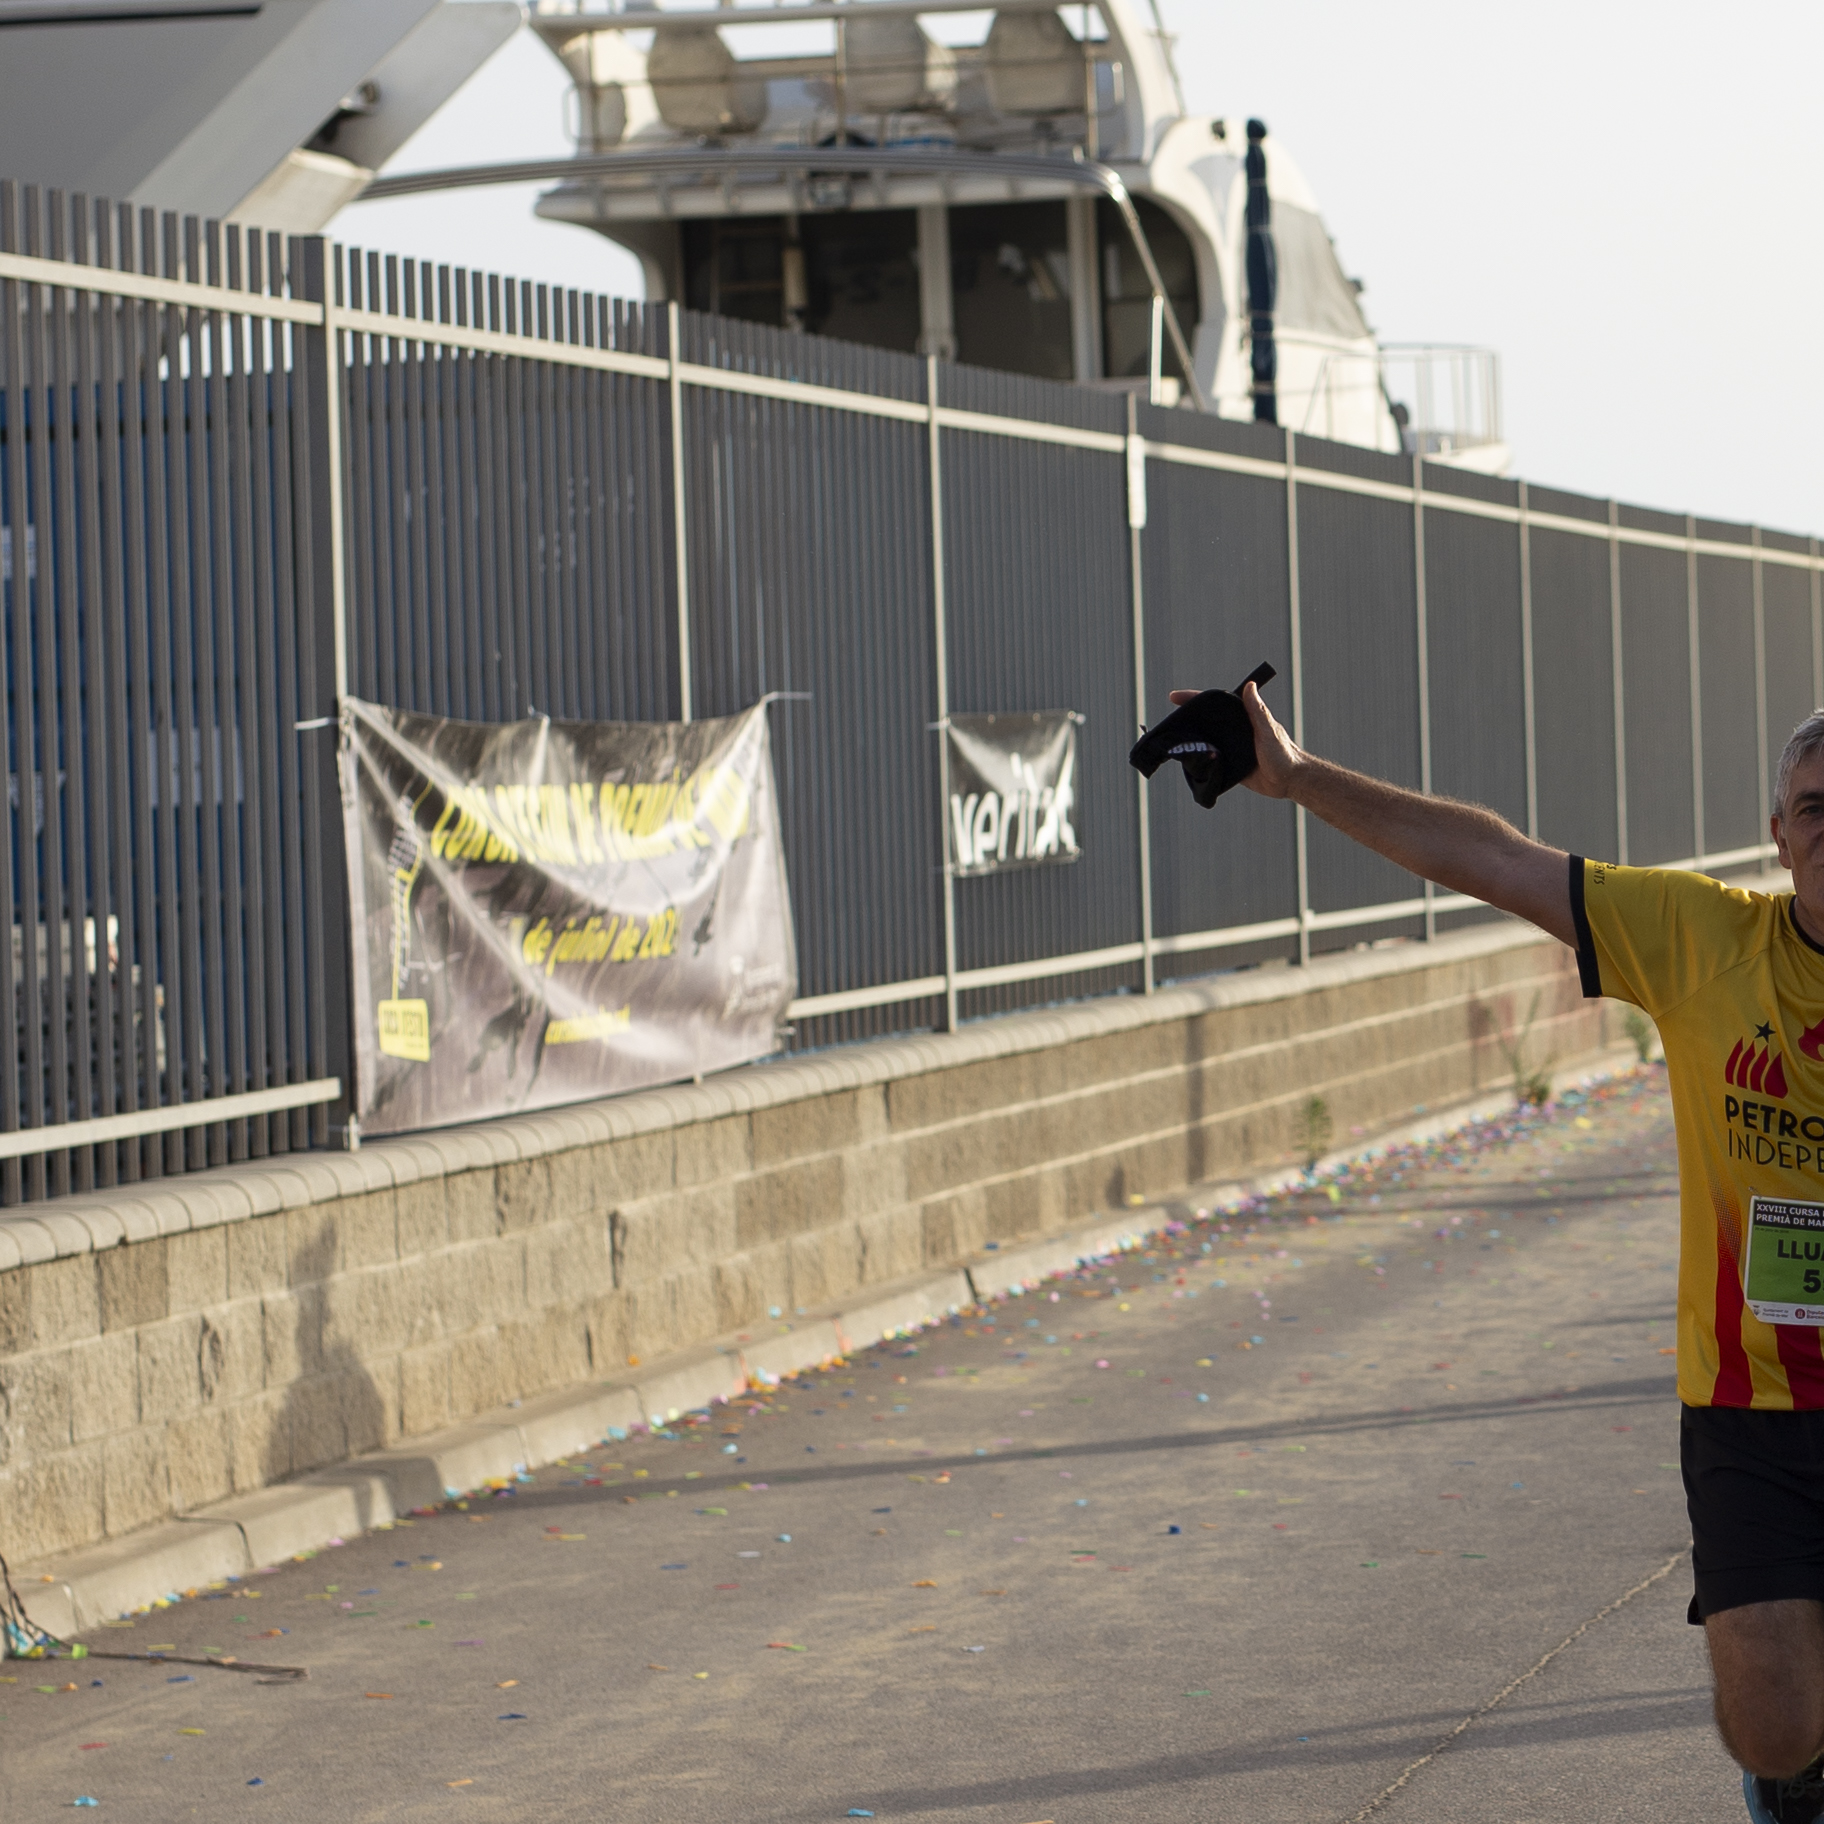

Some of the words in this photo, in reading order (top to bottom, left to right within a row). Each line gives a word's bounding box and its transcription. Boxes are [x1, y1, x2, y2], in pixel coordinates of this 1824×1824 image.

[1756, 1202, 1787, 1214] XXVIII
[1789, 1207, 1820, 1218] CURSA
[1756, 1213, 1791, 1224] PREMIÀ
[1793, 1217, 1806, 1226] DE
